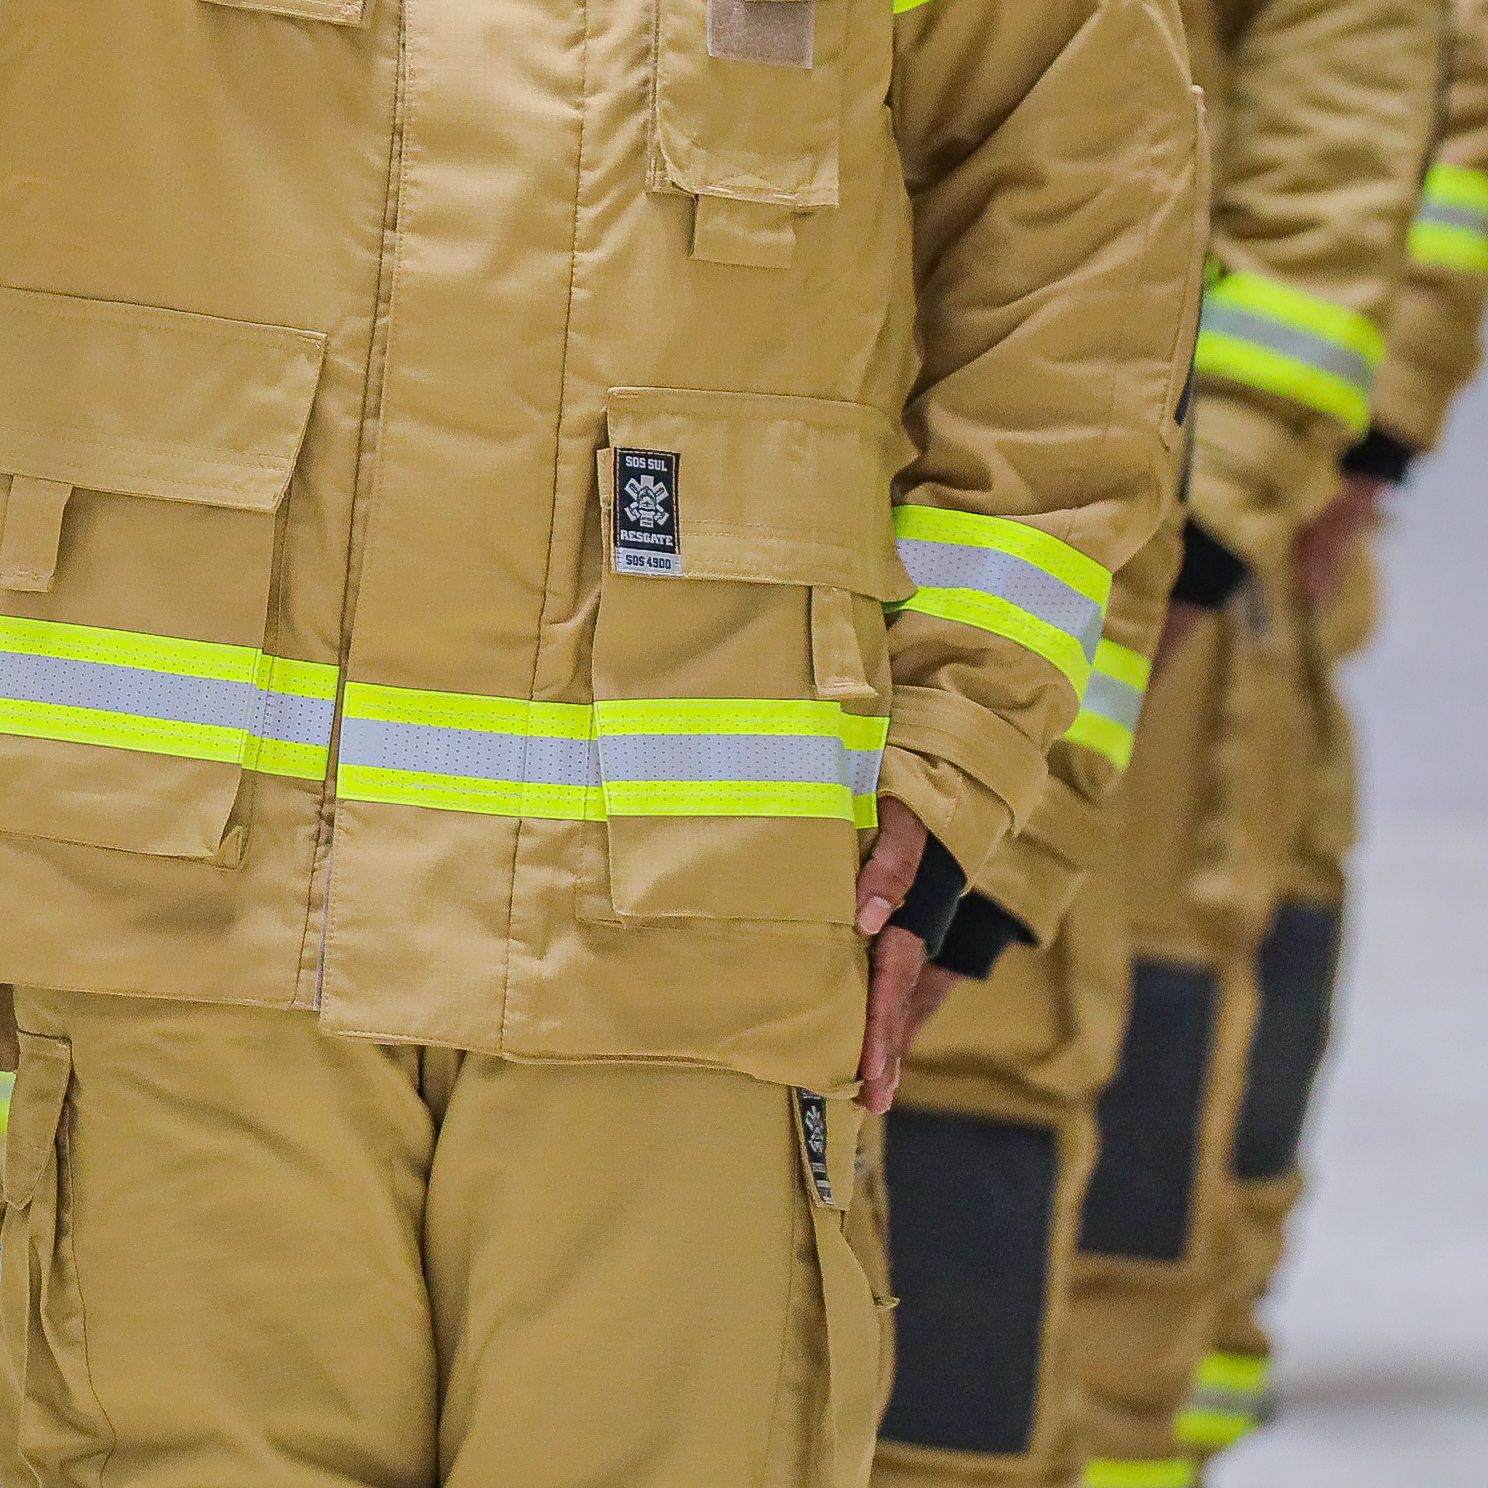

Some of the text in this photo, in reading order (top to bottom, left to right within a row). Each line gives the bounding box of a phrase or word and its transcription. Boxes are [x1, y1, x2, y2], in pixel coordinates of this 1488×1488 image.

[625, 455, 668, 472] SOS SUL
[620, 529, 674, 547] RESGATE
[625, 554, 672, 570] SOS 4900
